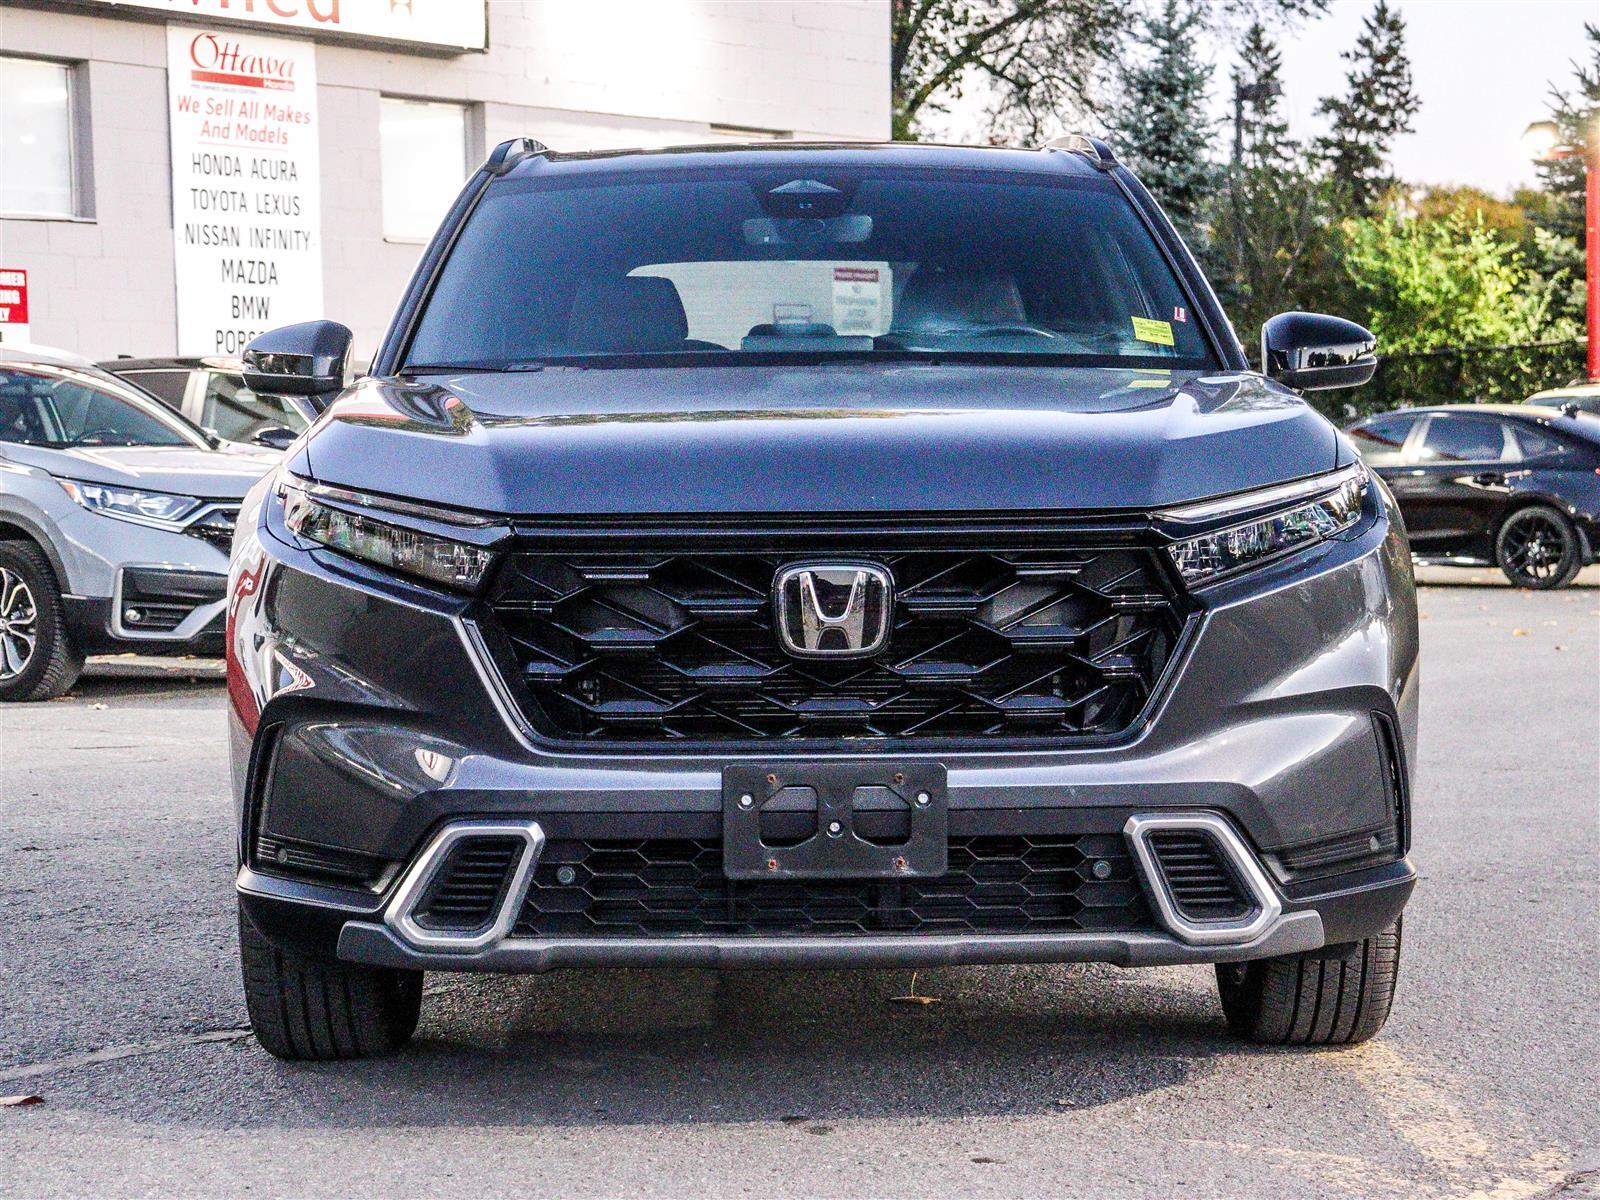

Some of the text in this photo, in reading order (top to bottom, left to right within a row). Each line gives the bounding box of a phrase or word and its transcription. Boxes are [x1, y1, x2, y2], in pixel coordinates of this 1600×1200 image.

[190, 31, 295, 78] Ottawa
[177, 94, 311, 125] We Sell All Makes
[201, 119, 289, 145] And Models
[191, 152, 298, 181] HONDA ACURA
[190, 187, 301, 216] TOYOTA LEXUS
[184, 223, 311, 252] NISSAN INFINITY
[221, 258, 279, 285] MAZDA
[231, 295, 270, 320] BMW
[215, 329, 265, 354] POR
